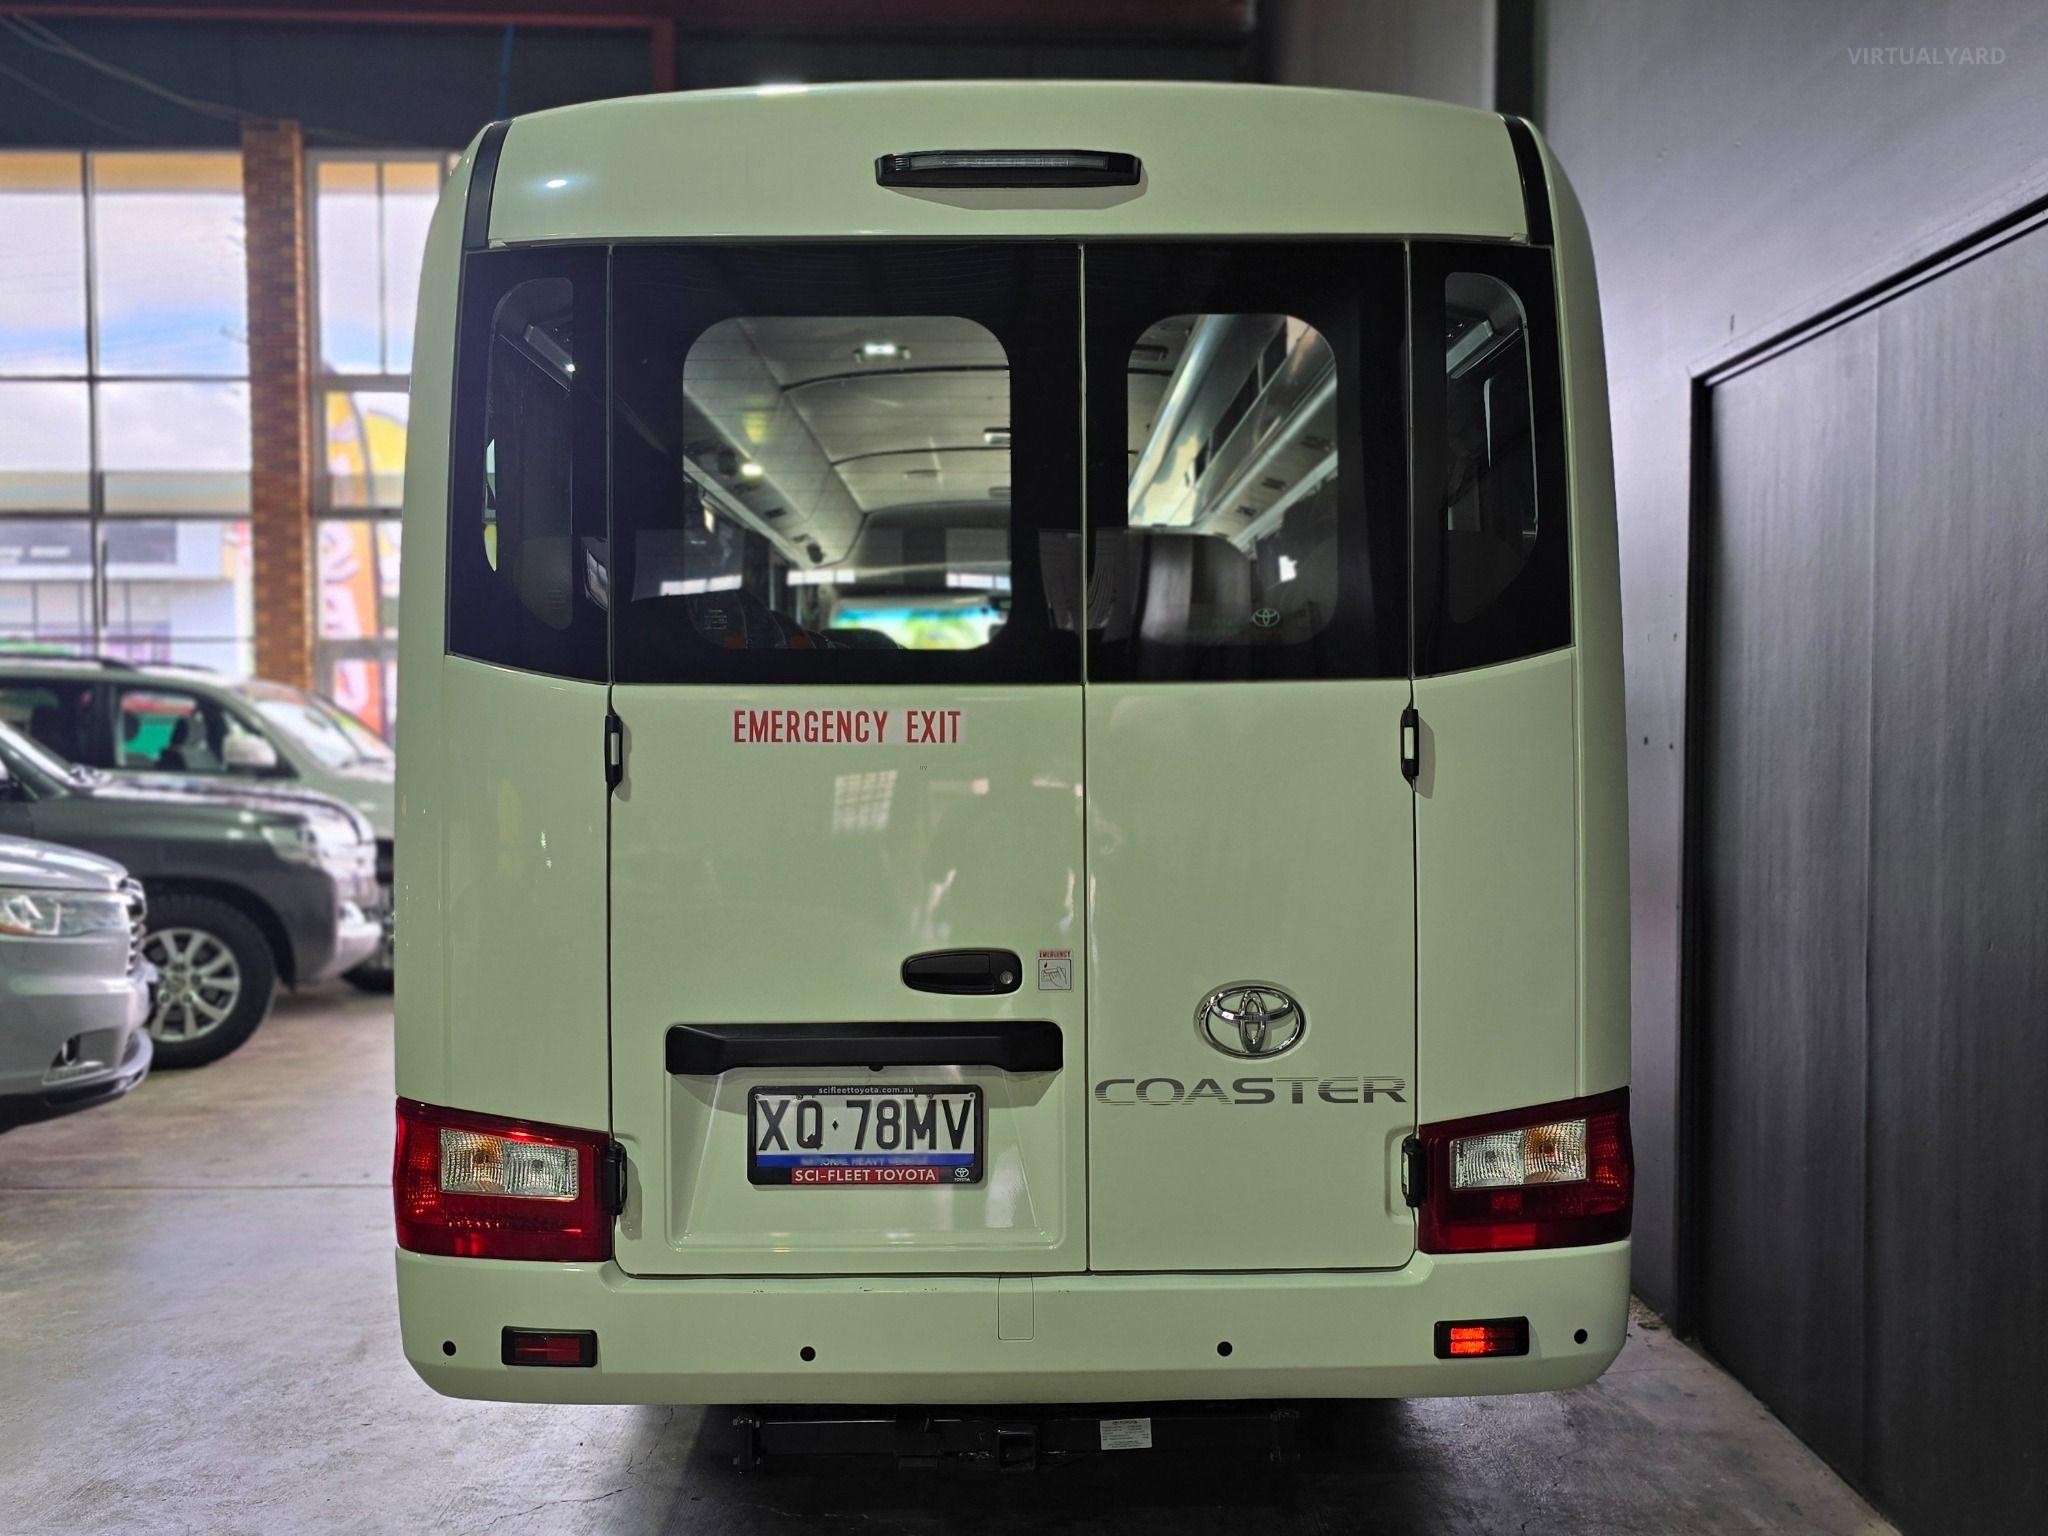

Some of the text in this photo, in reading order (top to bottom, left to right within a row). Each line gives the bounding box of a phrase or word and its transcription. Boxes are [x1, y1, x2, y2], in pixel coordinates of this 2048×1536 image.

[733, 710, 961, 743] EMERGENCY EXIT
[818, 1086, 914, 1095] scifleettoyota.com.au
[1094, 1076, 1408, 1106] COASTER
[801, 1157, 848, 1166] IONAL
[794, 1168, 937, 1182] SCI-FLEET TOYOTA
